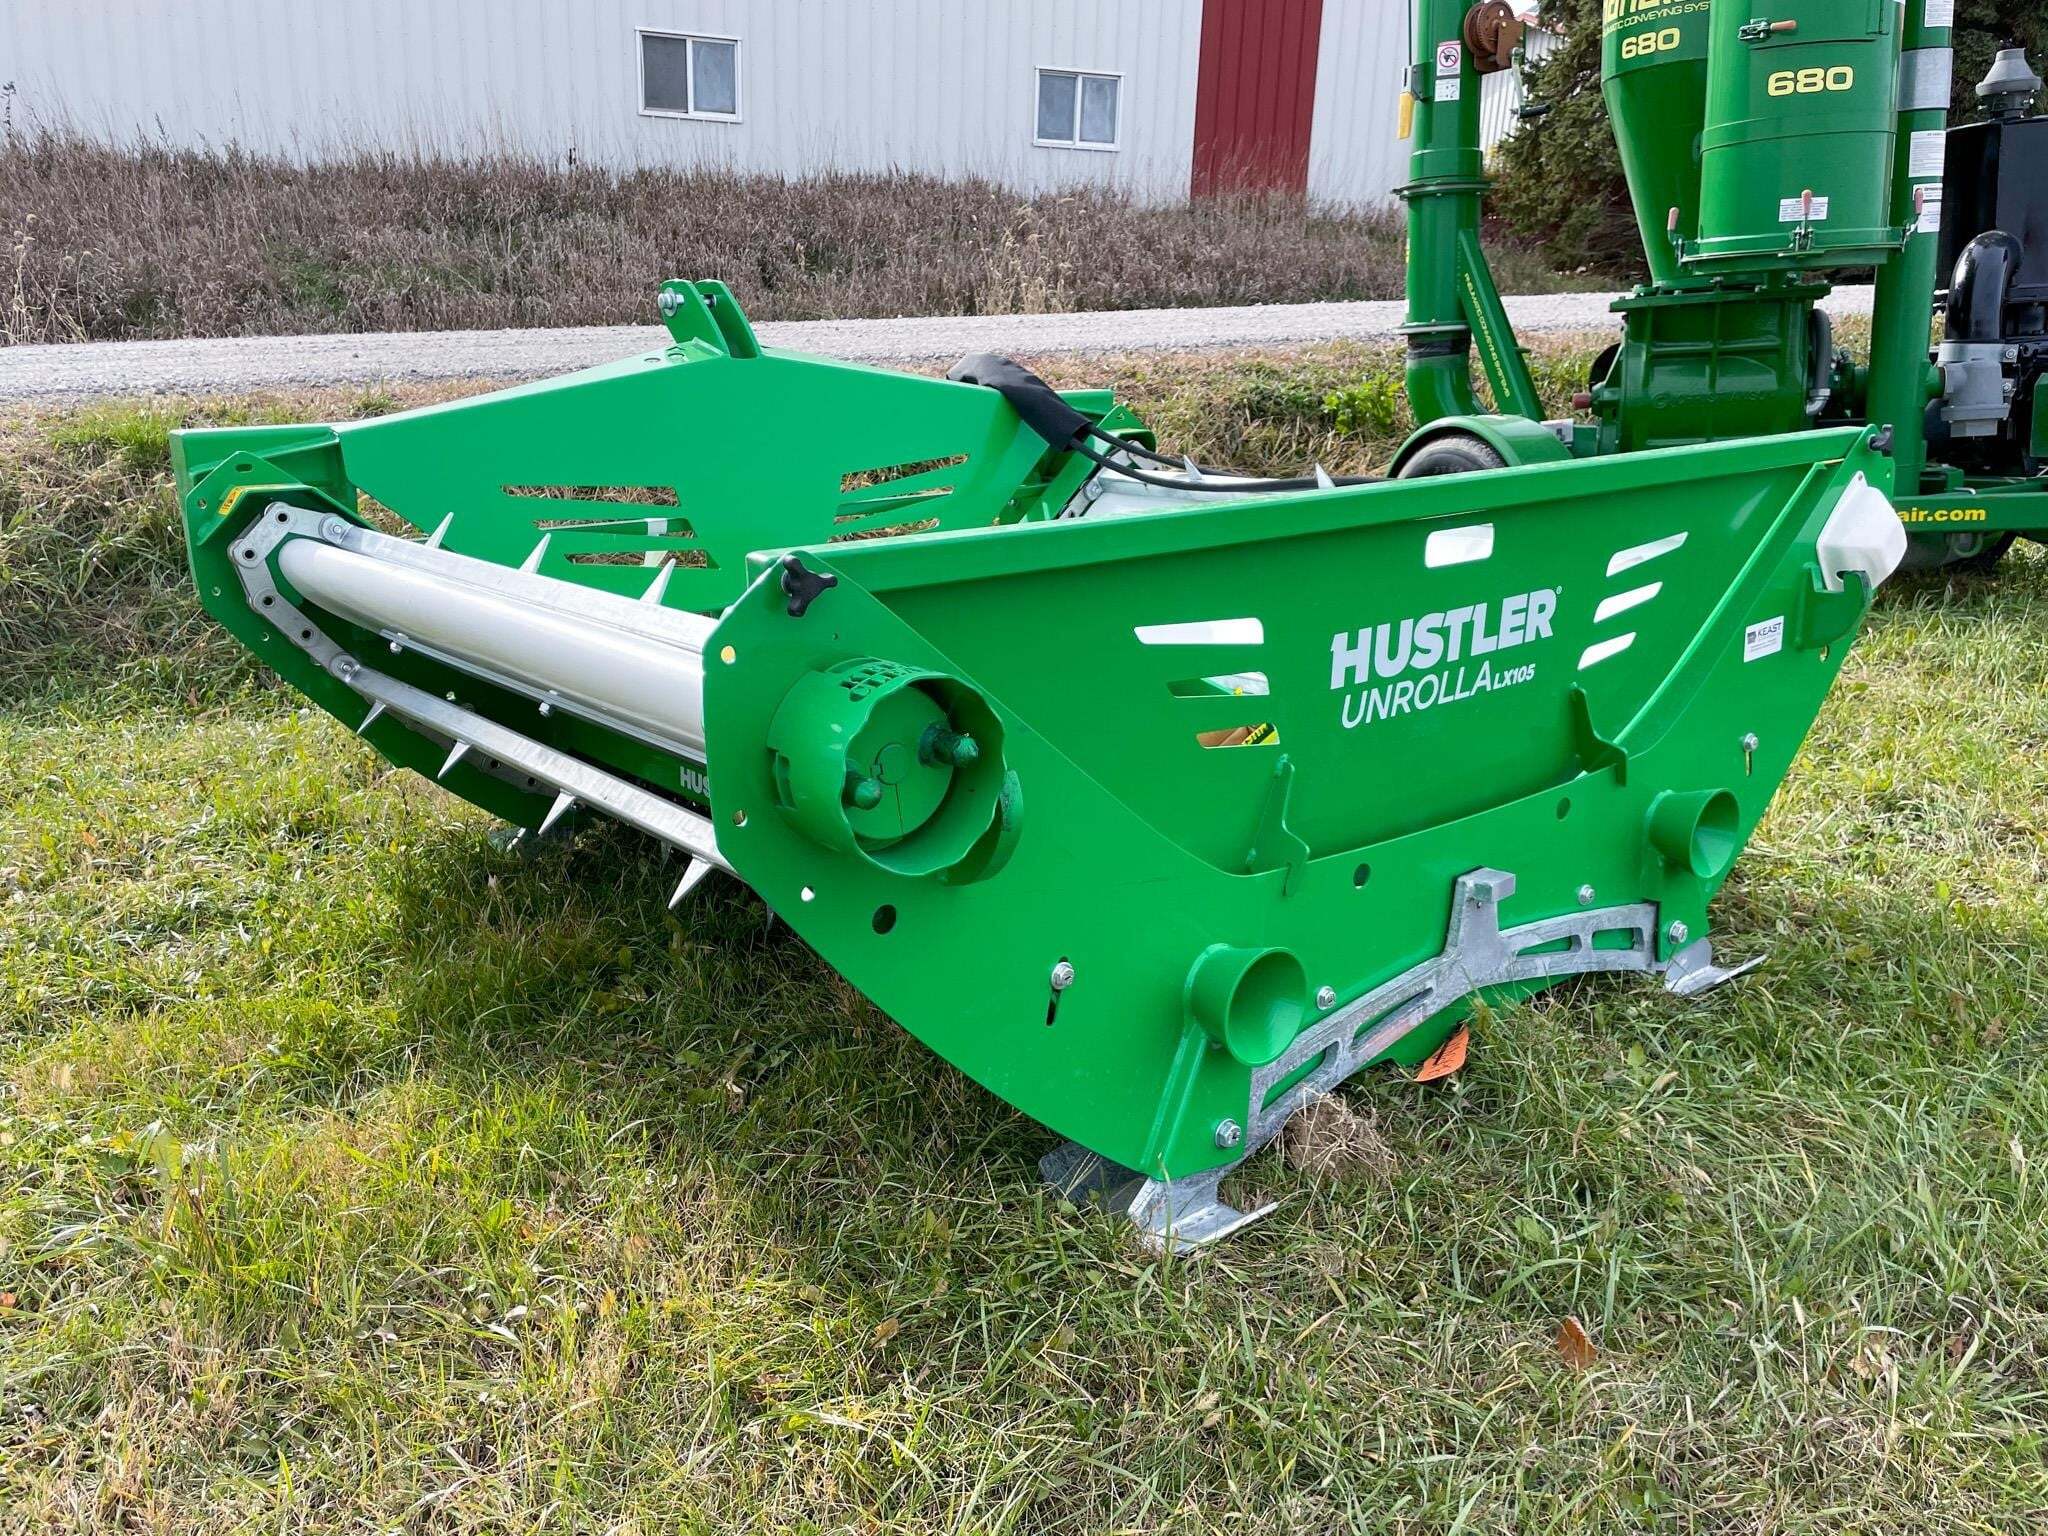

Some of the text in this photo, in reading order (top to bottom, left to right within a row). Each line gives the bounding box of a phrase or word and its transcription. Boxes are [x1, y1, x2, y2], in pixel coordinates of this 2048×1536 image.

[1624, 6, 1683, 28] CONVEYING
[1621, 27, 1680, 60] 680
[1767, 65, 1854, 97] 680
[1330, 587, 1558, 690] HUSTLER
[1341, 660, 1537, 729] UNROLLA LX105
